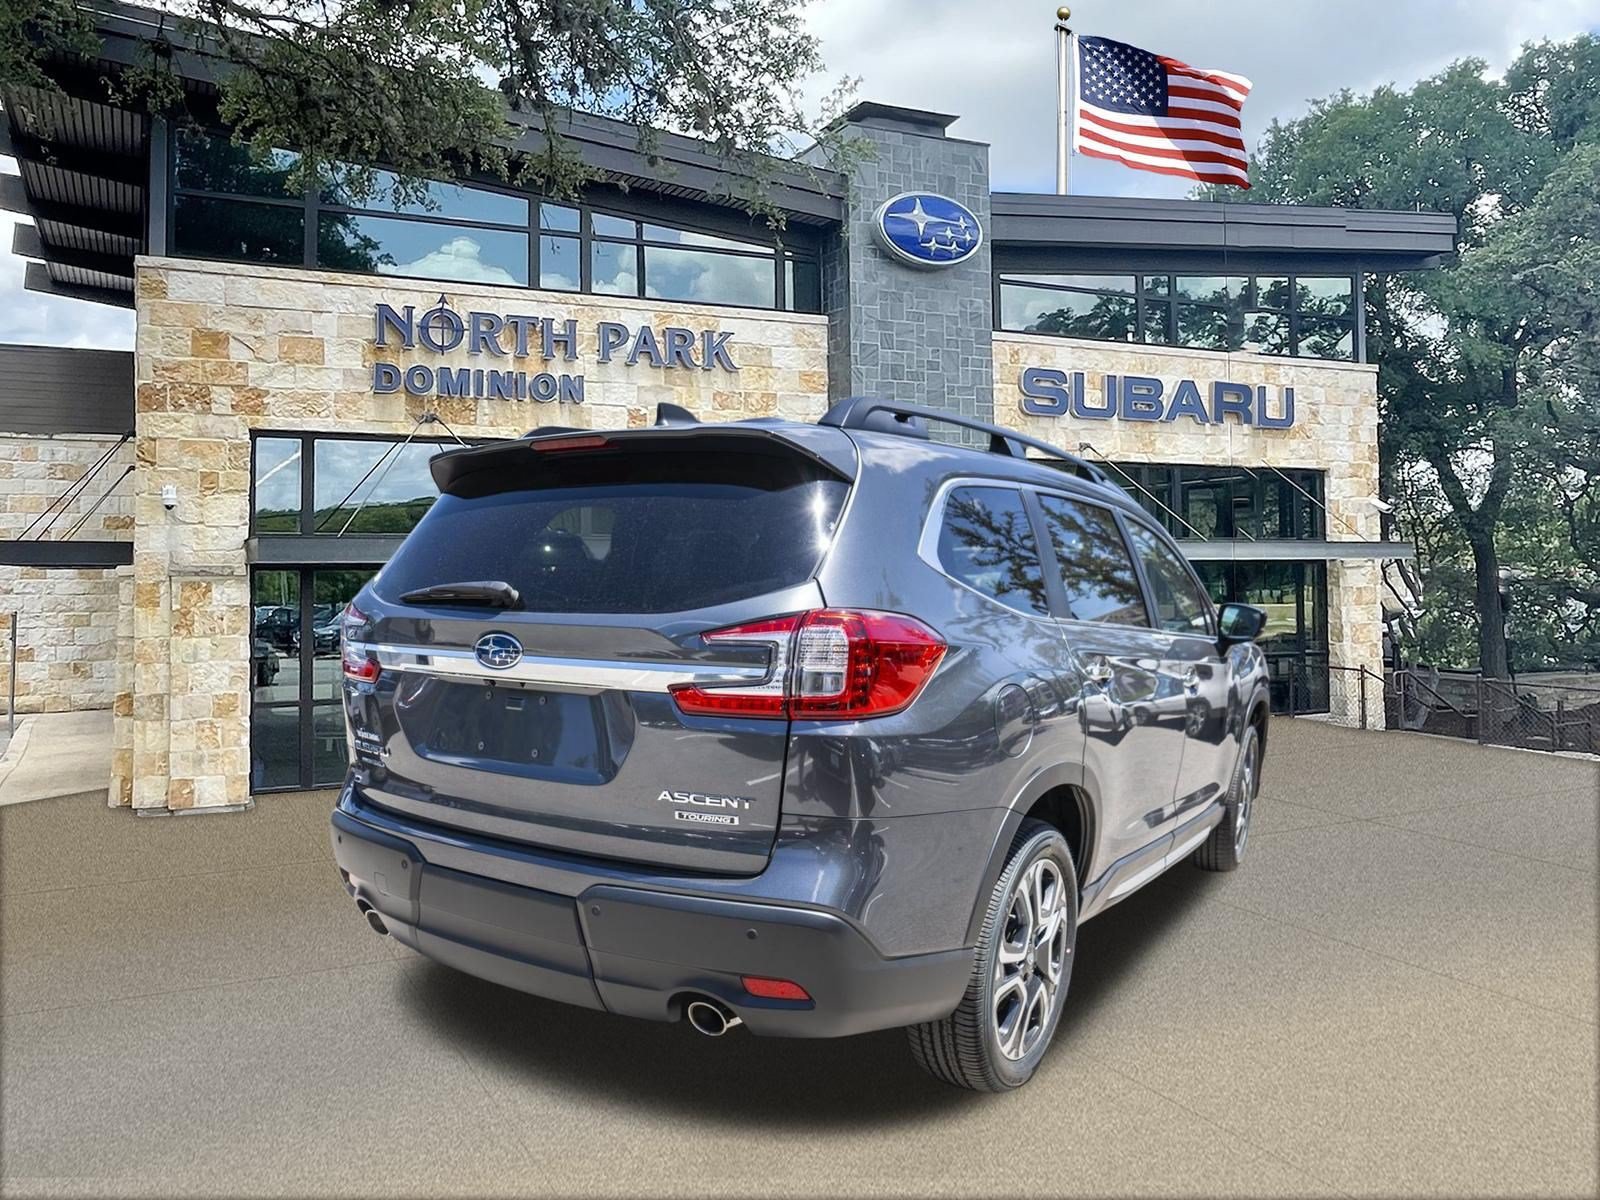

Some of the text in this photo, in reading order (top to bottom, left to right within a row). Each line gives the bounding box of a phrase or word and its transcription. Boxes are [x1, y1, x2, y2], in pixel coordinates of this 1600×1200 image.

[374, 296, 741, 373] NORTH PARK
[373, 362, 584, 404] DOMINION
[1019, 367, 1295, 429] SUBARU
[657, 790, 755, 810] ASCENT
[681, 812, 732, 824] TOURING
